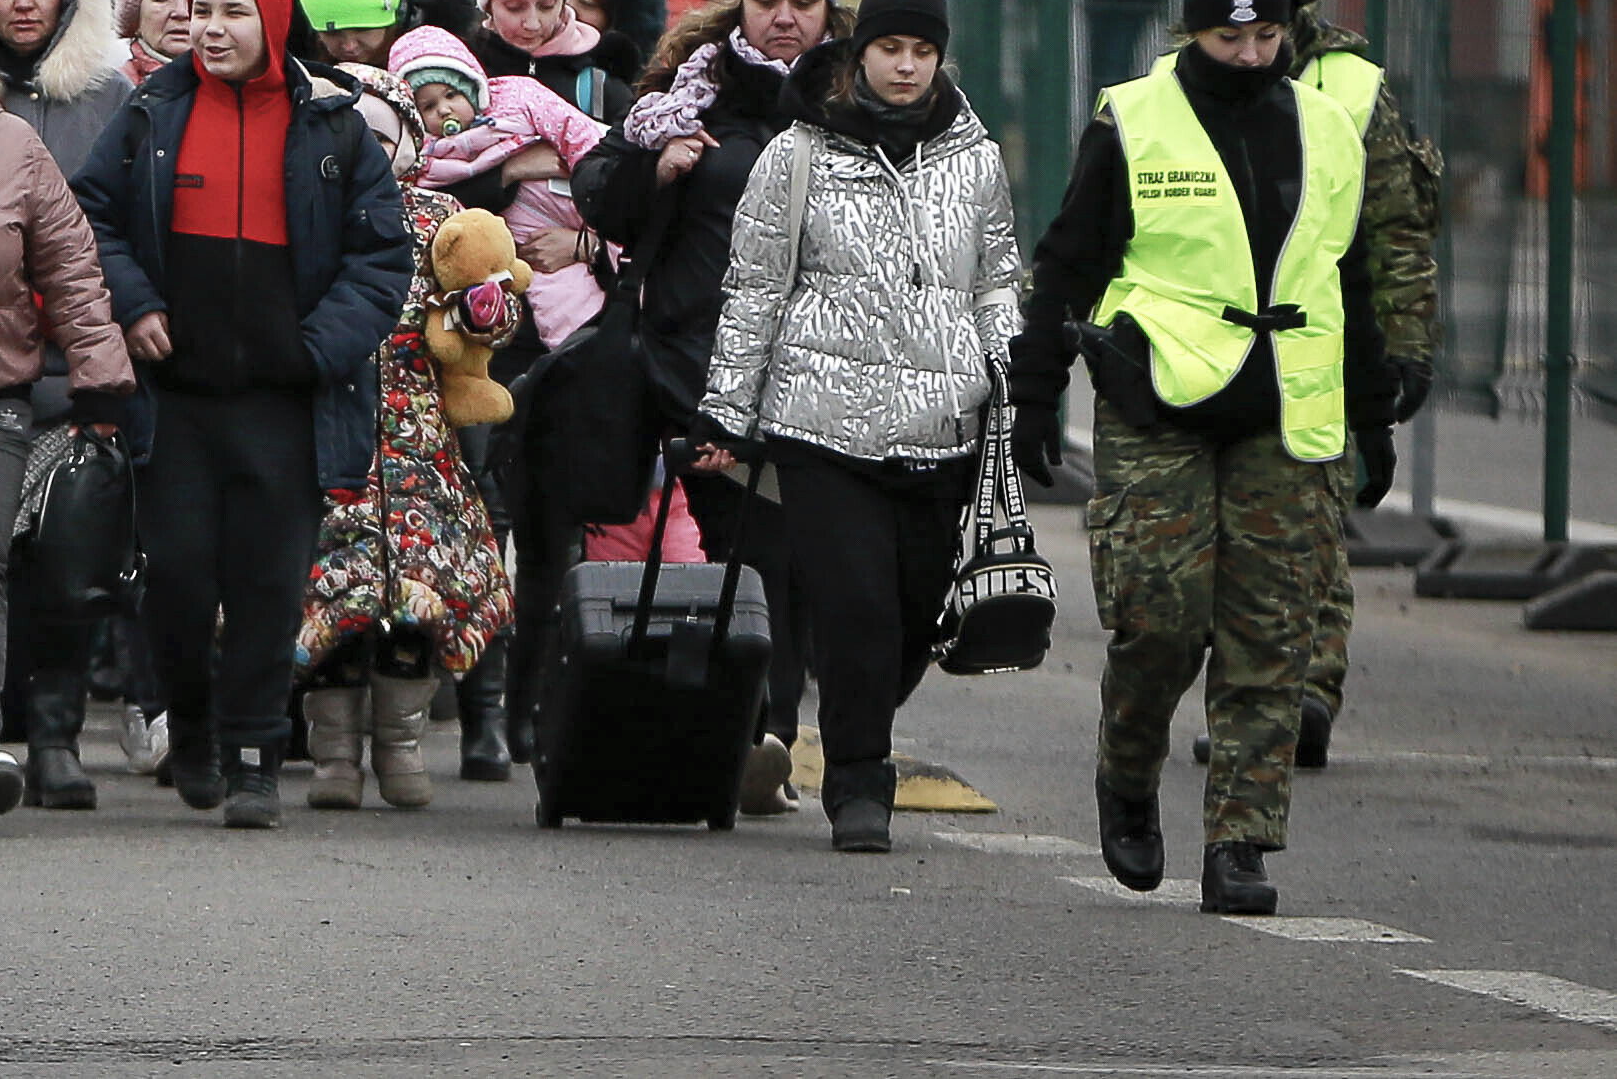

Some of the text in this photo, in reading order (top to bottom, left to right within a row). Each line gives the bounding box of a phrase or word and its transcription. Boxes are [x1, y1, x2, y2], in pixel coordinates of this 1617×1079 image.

[1167, 170, 1217, 183] GRANICZNA
[979, 478, 994, 515] GUESS
[1006, 476, 1022, 514] GUESS
